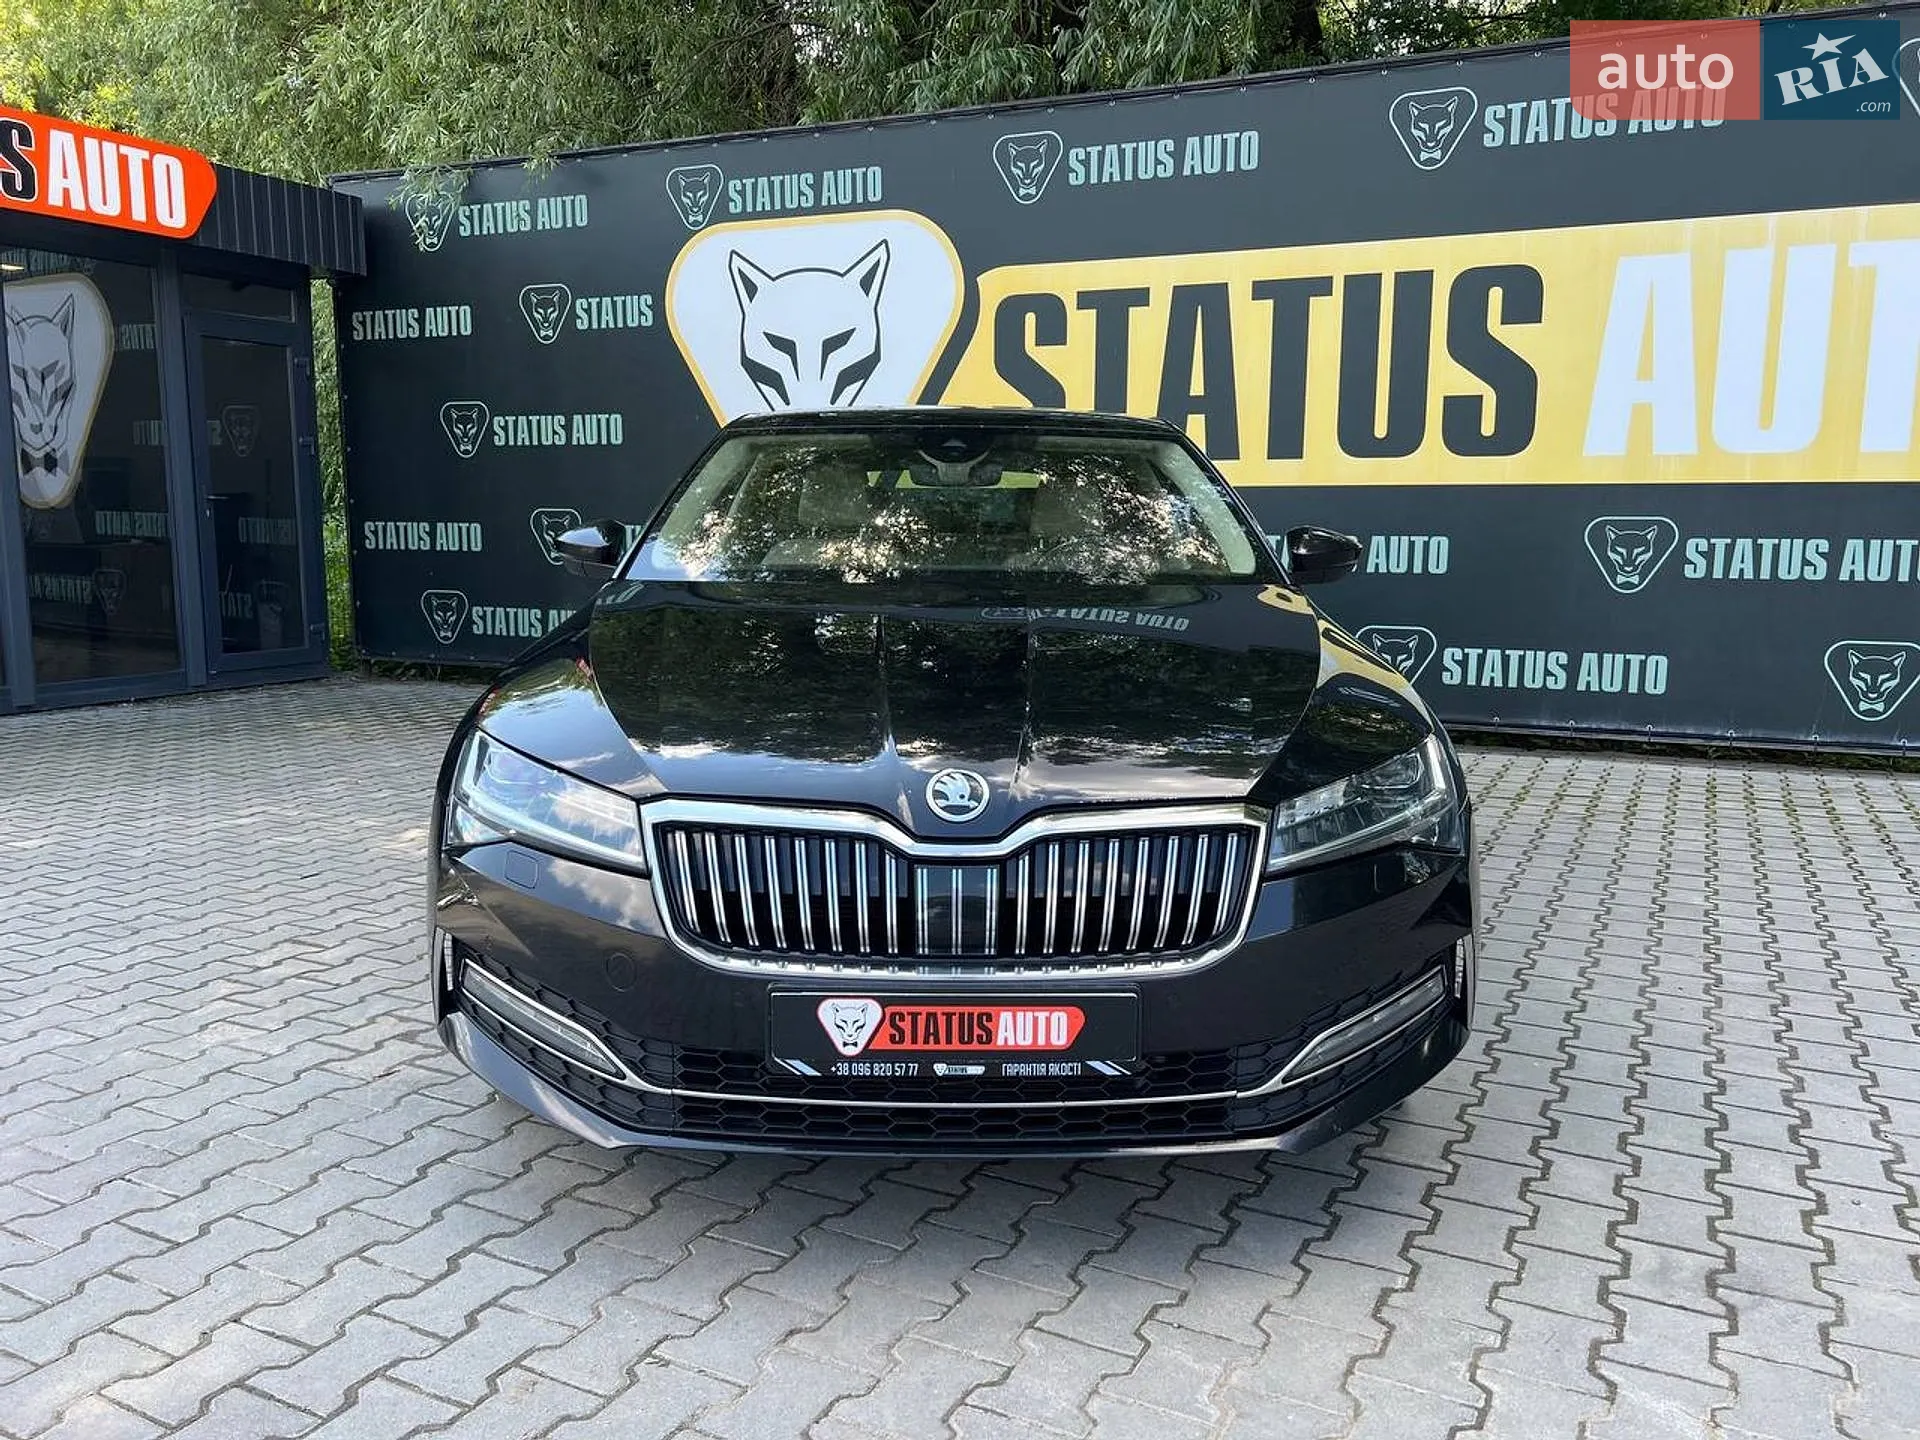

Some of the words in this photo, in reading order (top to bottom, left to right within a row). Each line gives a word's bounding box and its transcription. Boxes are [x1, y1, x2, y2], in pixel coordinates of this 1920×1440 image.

[1483, 92, 1618, 148] STATUS
[1628, 86, 1727, 134] AUTO
[48, 128, 188, 229] AUTO
[1068, 140, 1174, 186] STATUS
[1183, 131, 1259, 175] AUTO
[728, 173, 815, 214] STATUS
[822, 167, 882, 207] AUTO
[458, 200, 531, 237] STATUS
[537, 195, 588, 231] AUTO
[352, 309, 419, 341] STATUS
[425, 306, 472, 337] AUTO
[575, 295, 653, 330] STATUS
[994, 264, 1544, 460] STATUS
[1582, 238, 1920, 456] AUT
[493, 415, 566, 445] STATUS
[572, 414, 623, 445] AUTO
[364, 522, 430, 551] STATUS
[436, 523, 483, 552] AUTO
[1367, 535, 1449, 575] AUTO
[1684, 537, 1830, 581] STATUS
[1839, 538, 1920, 582] AUT
[471, 606, 543, 637] STATUS
[1441, 647, 1569, 689] STATUS
[1576, 652, 1668, 695] AUTO
[889, 1011, 993, 1046] STATUS
[996, 1011, 1069, 1046] AUTO
[831, 1063, 849, 1076] +38
[852, 1063, 871, 1077] 096
[873, 1063, 893, 1077] 820
[894, 1063, 906, 1077] 57
[908, 1063, 919, 1077] 77
[1001, 1063, 1047, 1077] ГАРАНТІЯ
[1048, 1062, 1082, 1076] ЯКОСТІ
